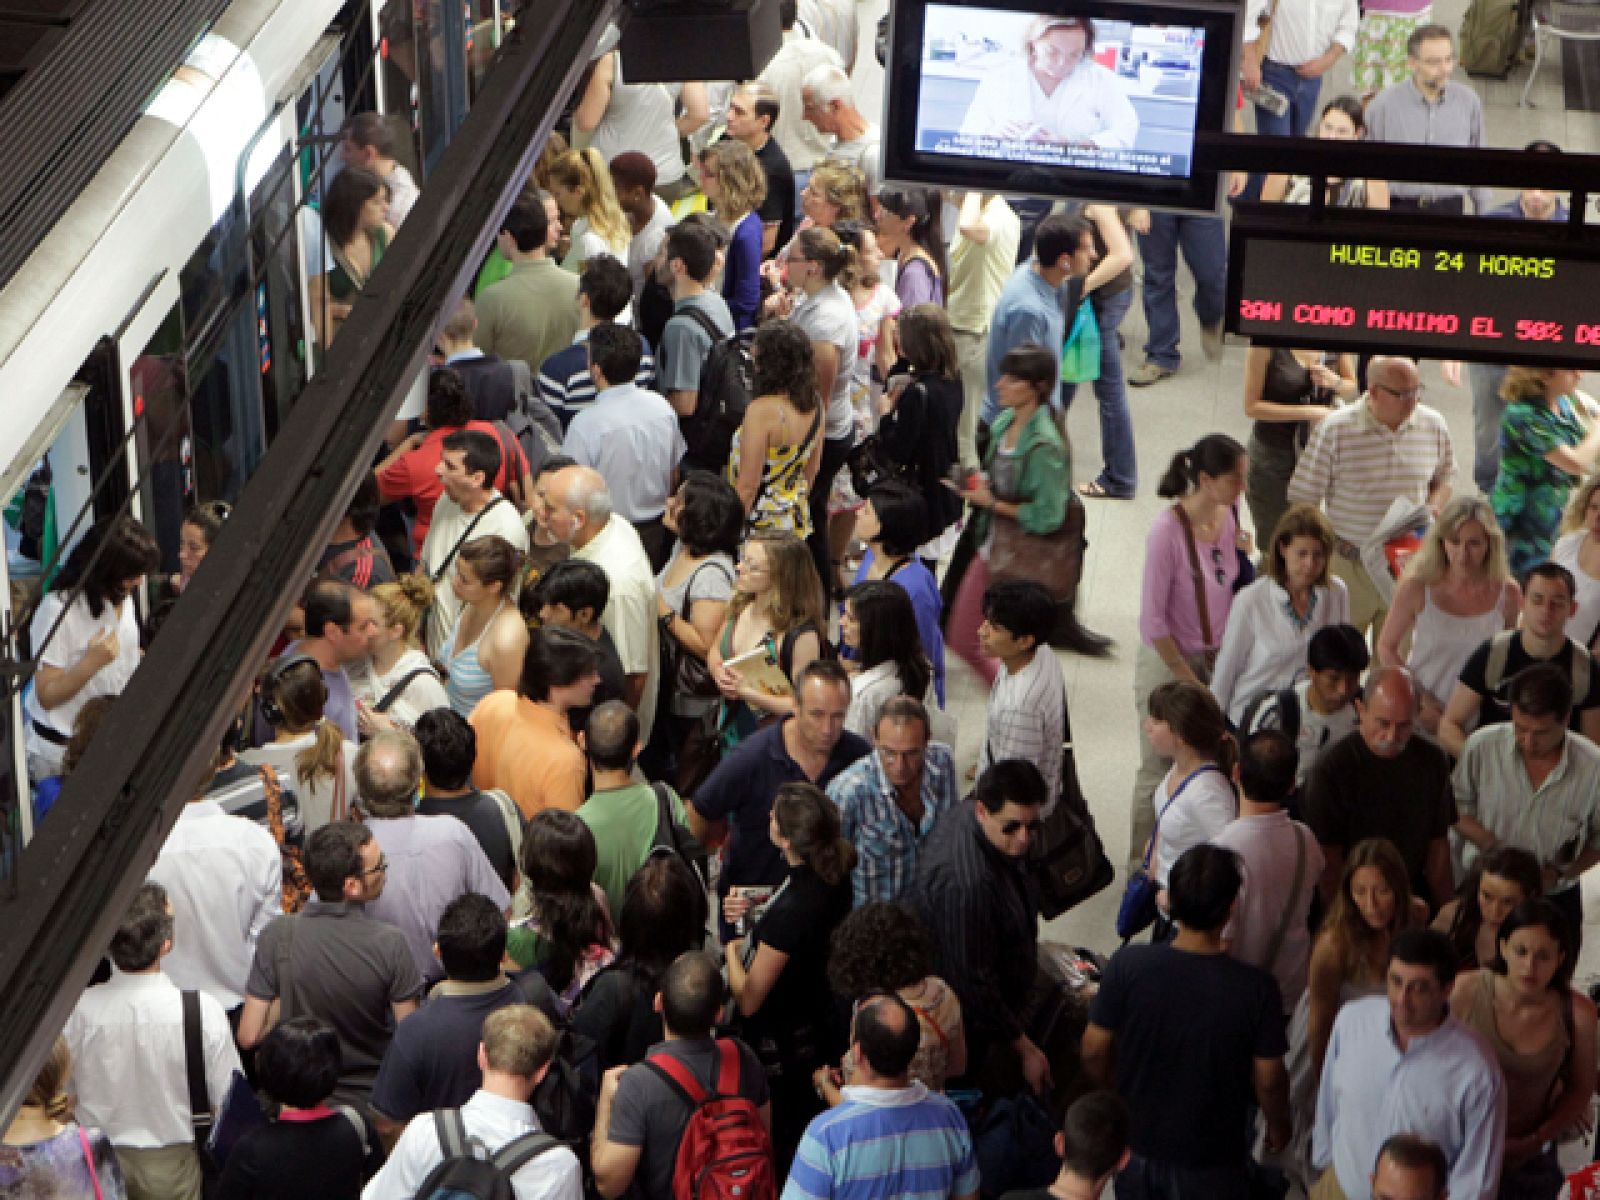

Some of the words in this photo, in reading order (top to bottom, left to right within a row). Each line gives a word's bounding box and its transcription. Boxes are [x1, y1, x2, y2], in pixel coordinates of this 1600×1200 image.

[1329, 244, 1421, 268] HUELGA
[1434, 251, 1464, 271] 24
[1479, 254, 1556, 279] HORAS
[1293, 303, 1356, 326] COMO
[1367, 309, 1459, 334] MINIMO
[1470, 316, 1503, 338] EL
[1515, 319, 1564, 343] 50%
